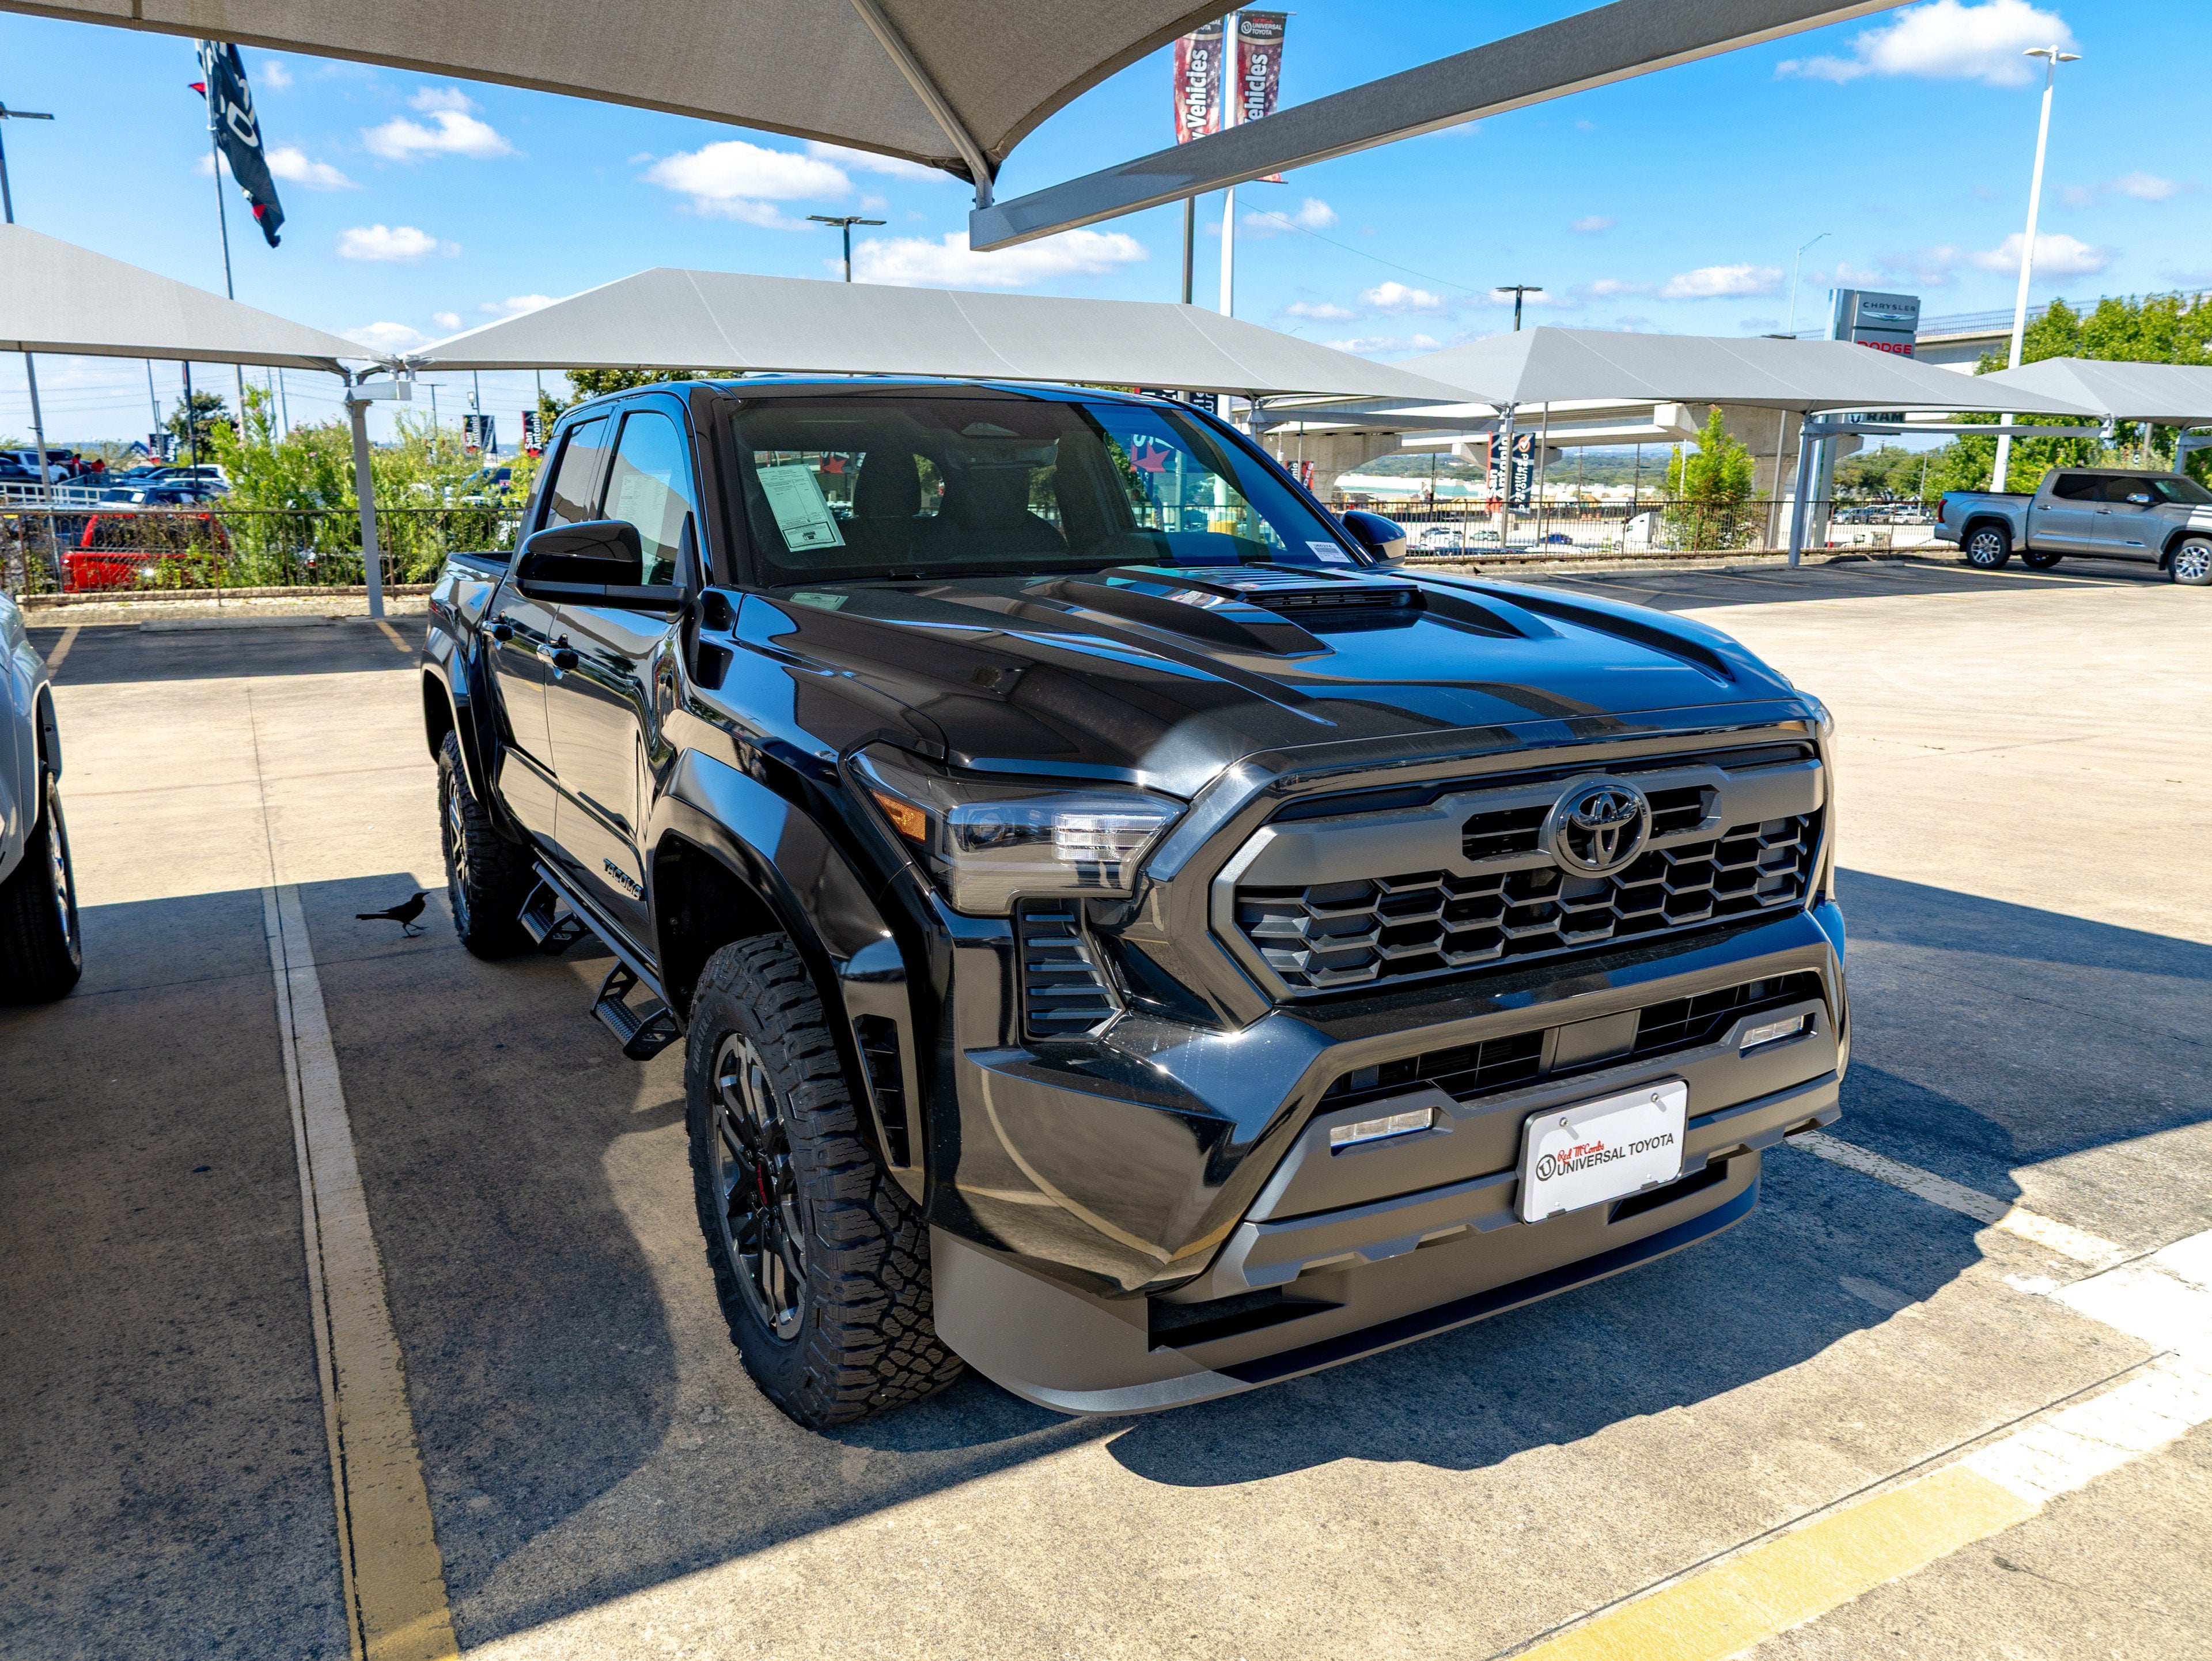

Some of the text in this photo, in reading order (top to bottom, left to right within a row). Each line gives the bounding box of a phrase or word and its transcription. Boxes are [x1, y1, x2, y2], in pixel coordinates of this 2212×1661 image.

[1185, 49, 1208, 128] Vehicles
[1863, 302, 1915, 312] CHRYSLER
[470, 416, 479, 447] Antonio
[531, 413, 542, 450] Antonio
[1866, 412, 1904, 421] RAM
[525, 432, 533, 449] San
[1487, 469, 1498, 499] San
[1497, 436, 1508, 499] Antonio
[1519, 453, 1529, 511] pe-owned
[603, 858, 645, 901] TACOMA
[1557, 1140, 1605, 1164] Red McCombs
[1558, 1133, 1674, 1176] UNIVERSAL TOYOTA
